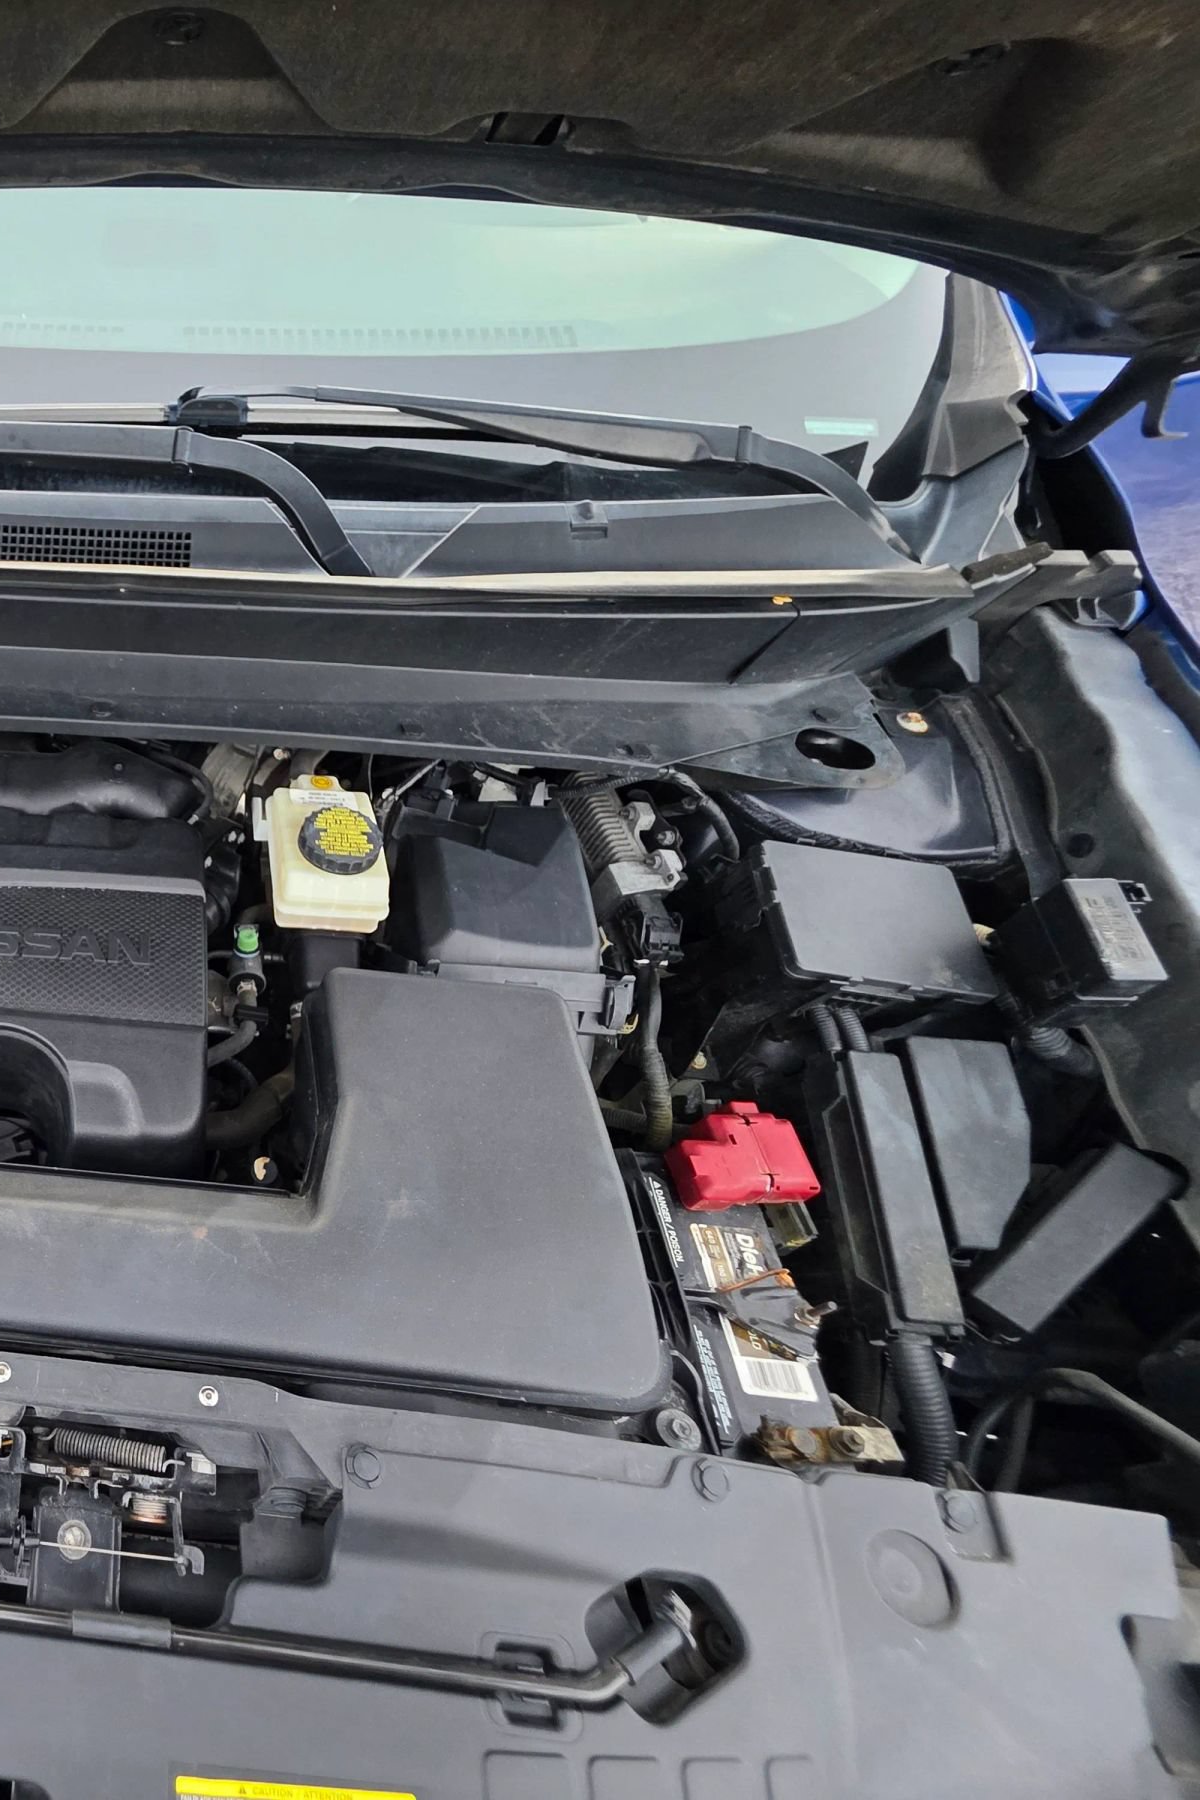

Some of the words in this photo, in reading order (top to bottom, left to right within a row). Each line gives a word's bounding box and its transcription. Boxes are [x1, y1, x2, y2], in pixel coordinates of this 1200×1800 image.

[656, 1190, 672, 1223] DANGER
[668, 1230, 684, 1262] POISON
[252, 1786, 293, 1798] CAUTION
[303, 1790, 353, 1800] ATTENTION
